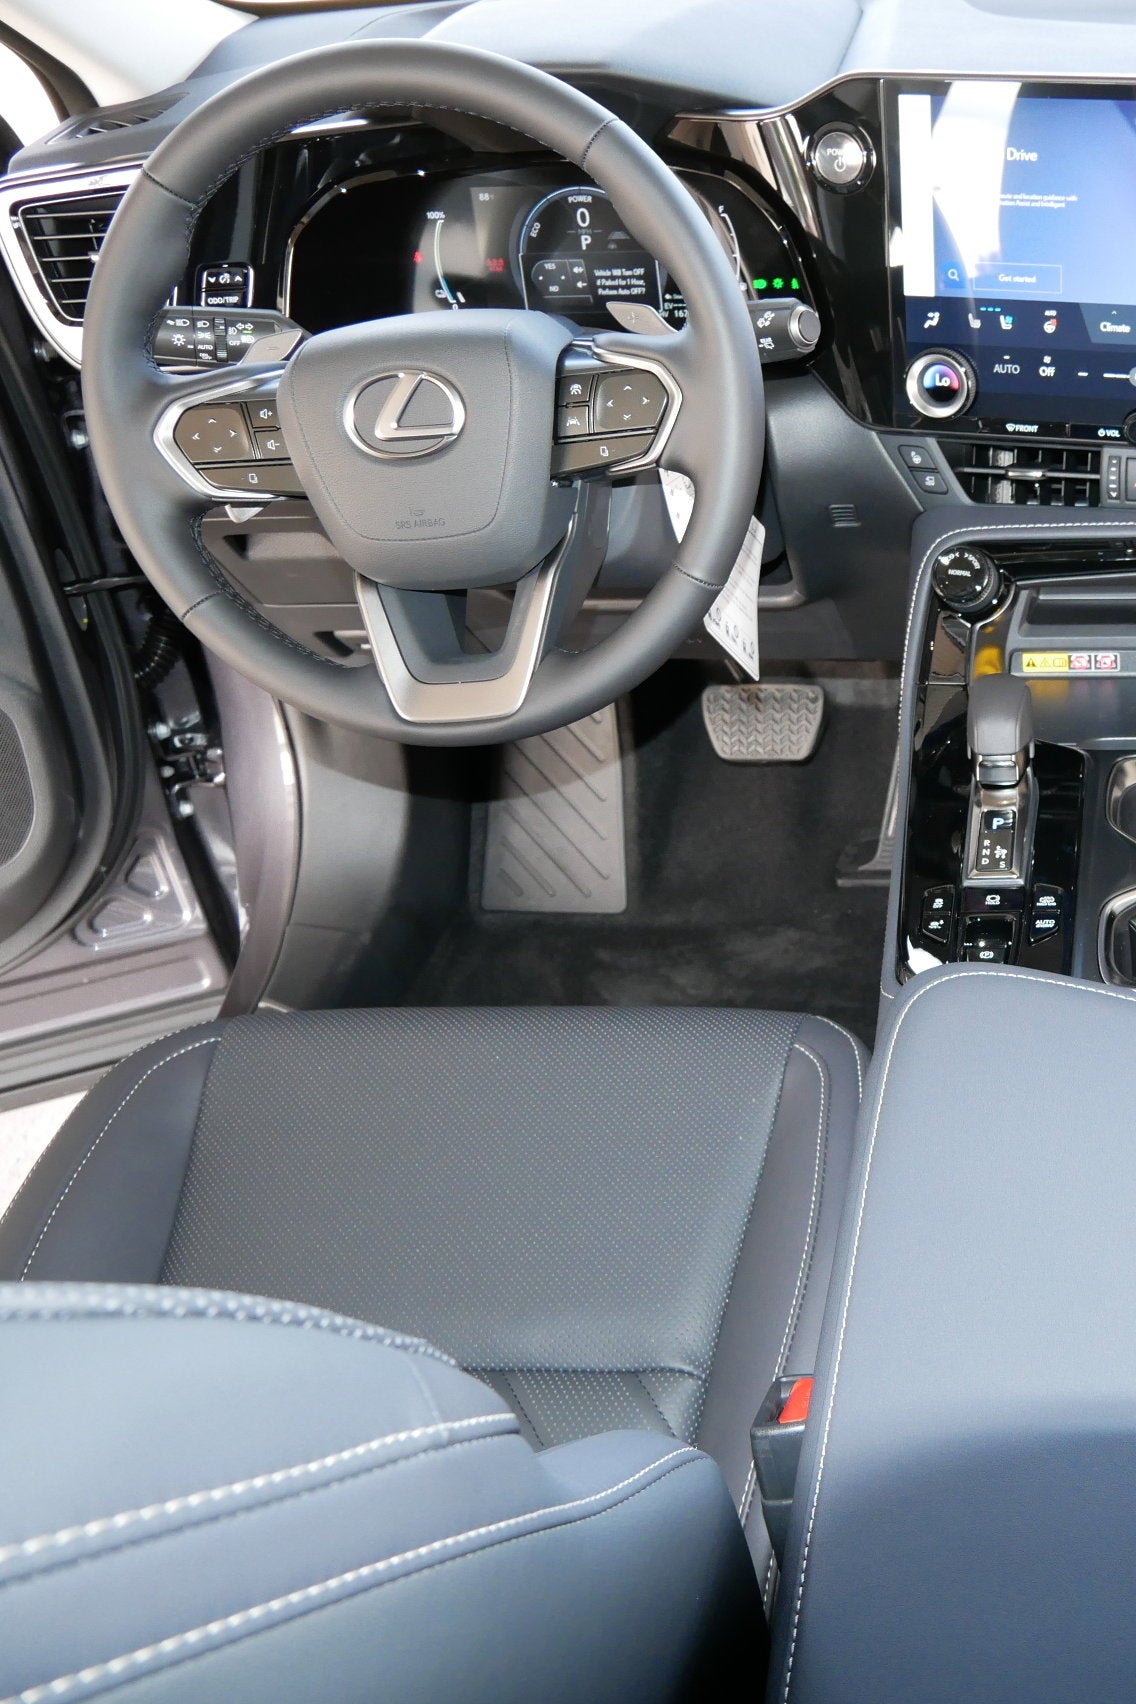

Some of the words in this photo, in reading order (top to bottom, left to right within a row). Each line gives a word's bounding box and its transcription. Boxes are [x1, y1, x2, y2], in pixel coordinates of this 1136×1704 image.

[1006, 147, 1038, 161] Drive
[568, 195, 593, 203] POWER
[718, 205, 725, 213] F
[426, 211, 446, 219] 100%
[576, 207, 590, 227] 0
[530, 222, 541, 238] ECO
[580, 235, 592, 250] P
[544, 262, 557, 270] YES
[633, 268, 645, 276] OFF
[999, 274, 1012, 282] Get
[1013, 275, 1036, 283] started
[549, 285, 559, 293] NO
[207, 296, 239, 305] ODO/TRIP
[1100, 321, 1131, 333] Climate
[993, 364, 1021, 375] AUTO
[1039, 366, 1056, 377] Off
[935, 373, 951, 387] Lo
[1015, 424, 1039, 433] FRONT
[1105, 429, 1121, 438] VOL
[948, 568, 972, 577] NORMAL
[992, 817, 1005, 830] P
[983, 839, 991, 847] R
